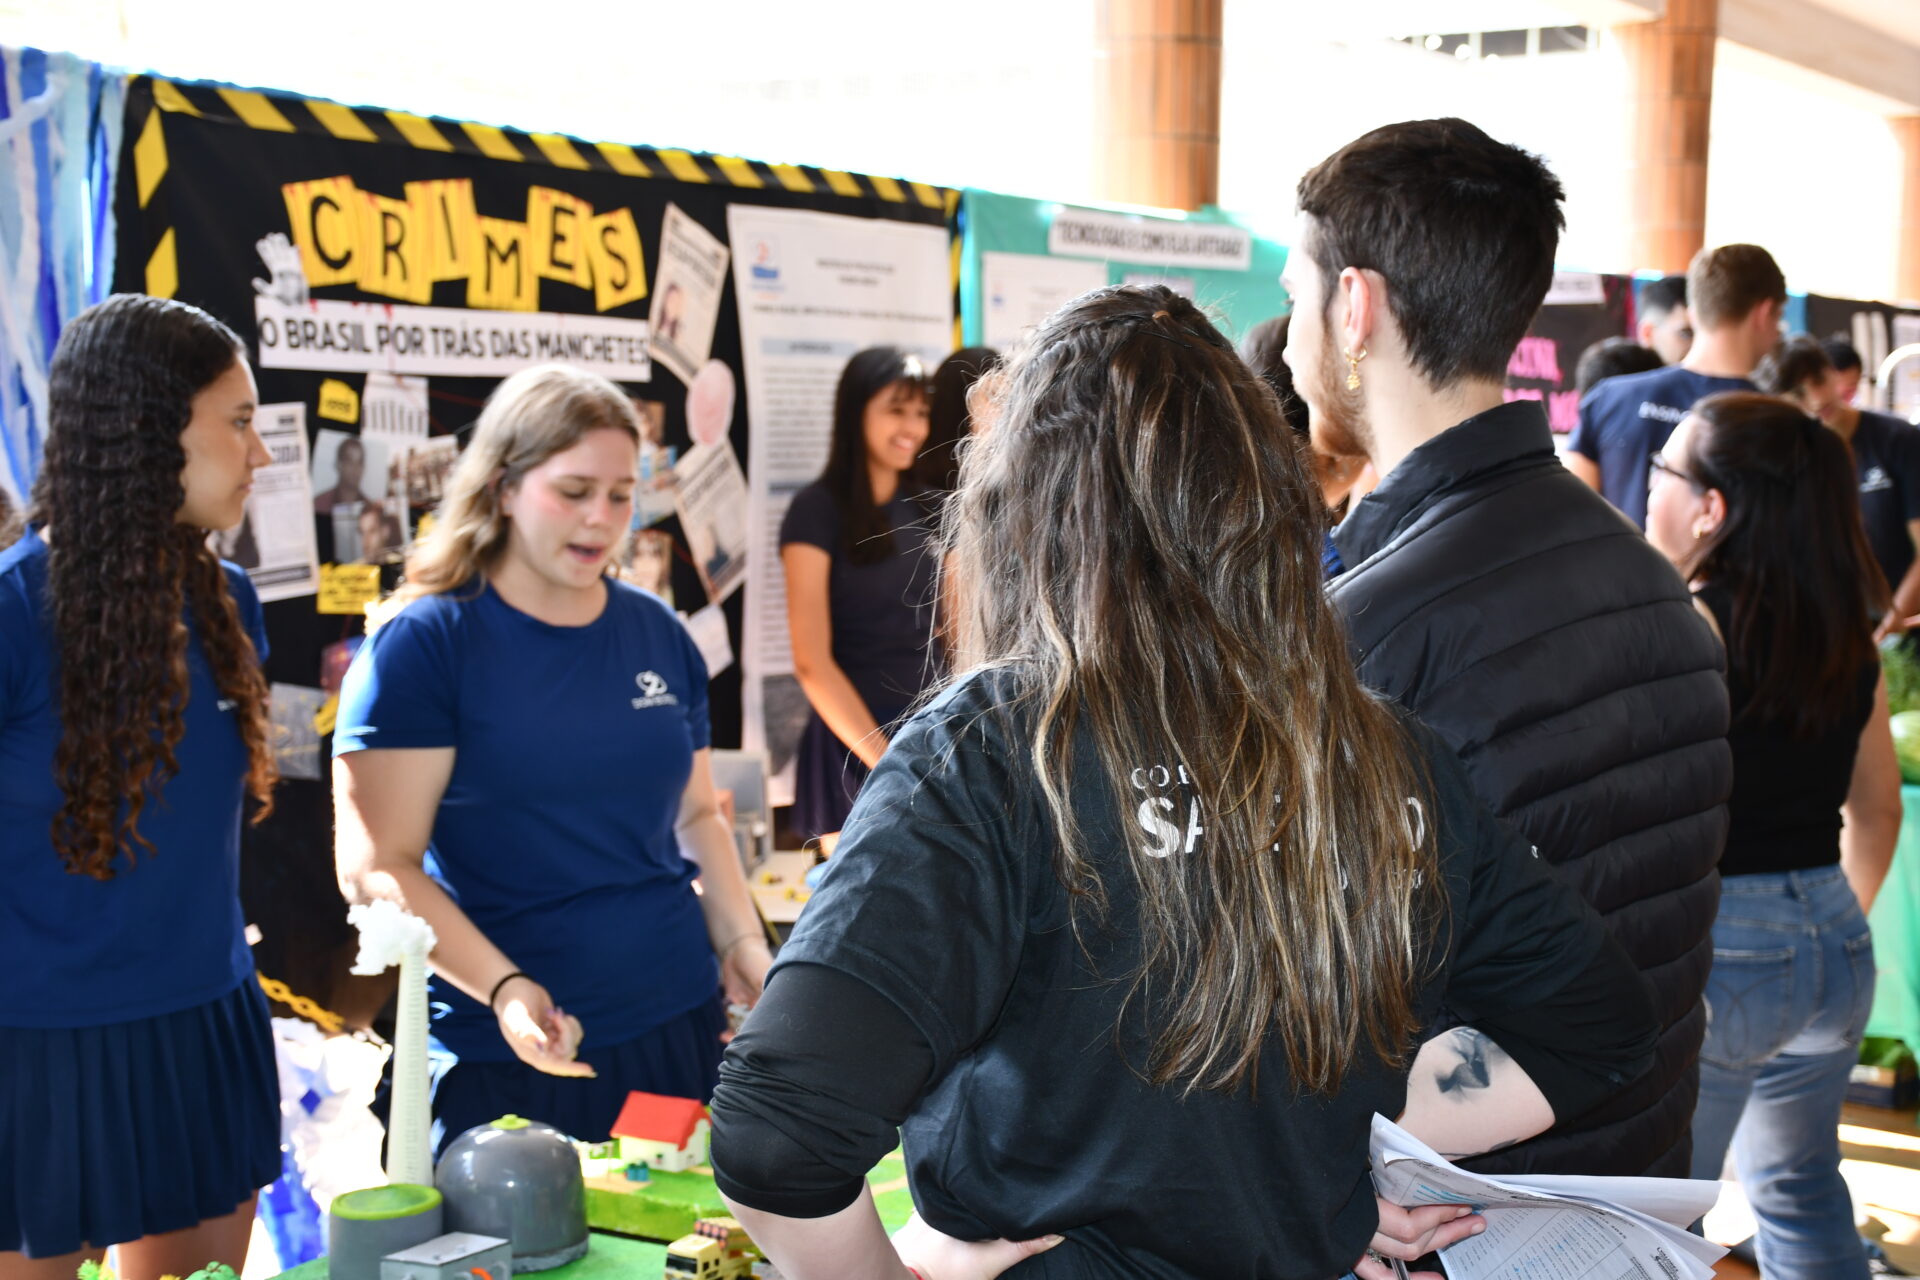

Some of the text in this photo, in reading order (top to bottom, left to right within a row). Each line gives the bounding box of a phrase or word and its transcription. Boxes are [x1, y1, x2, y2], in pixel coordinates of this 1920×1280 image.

[310, 193, 630, 299] CRIMES
[260, 318, 650, 364] O BRASIL POR TRÁS DAS MANCHETES
